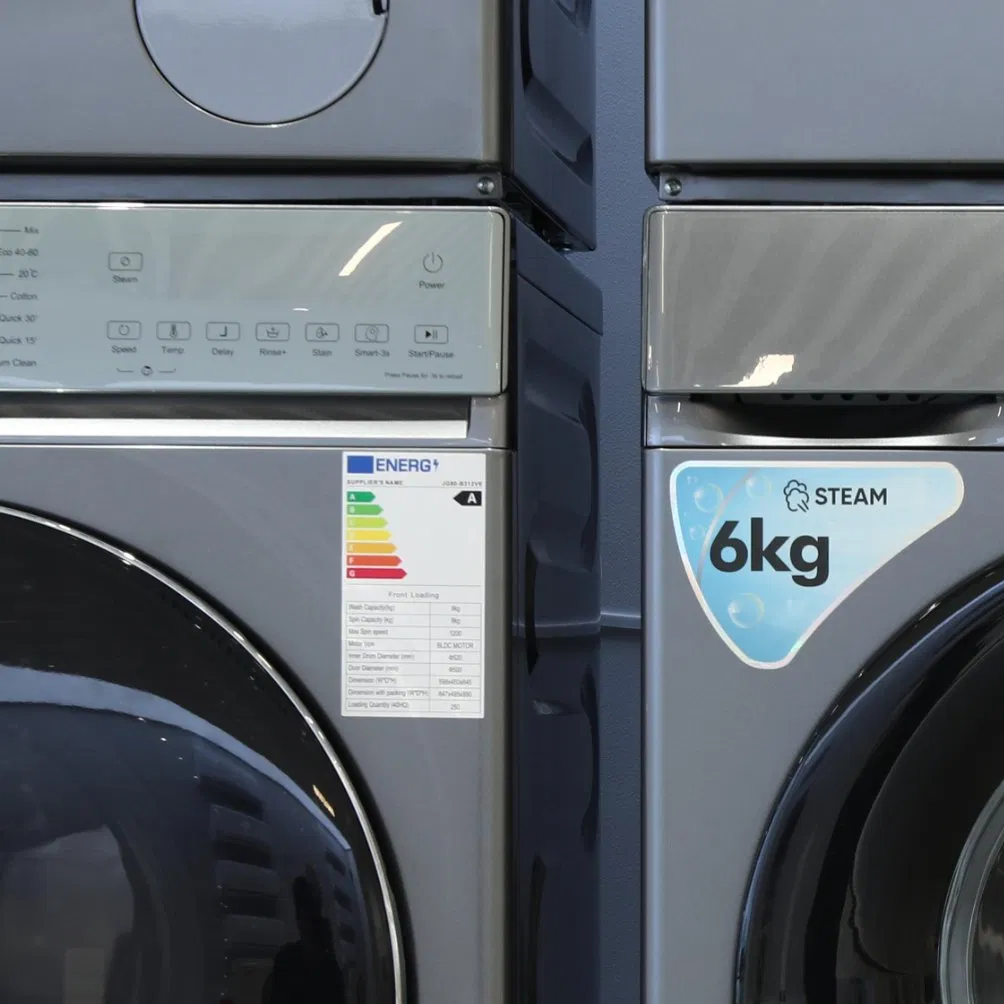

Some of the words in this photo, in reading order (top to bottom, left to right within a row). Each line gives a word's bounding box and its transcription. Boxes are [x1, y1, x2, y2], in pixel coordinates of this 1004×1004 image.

[112, 275, 138, 284] Steam
[418, 280, 446, 289] Power
[111, 345, 137, 354] Speed
[212, 348, 234, 357] Delay
[375, 458, 431, 473] ENERG
[349, 493, 356, 501] A
[467, 493, 477, 504] A
[815, 487, 887, 506] STEAM
[709, 517, 830, 588] 6kg
[411, 592, 440, 600] Loading
